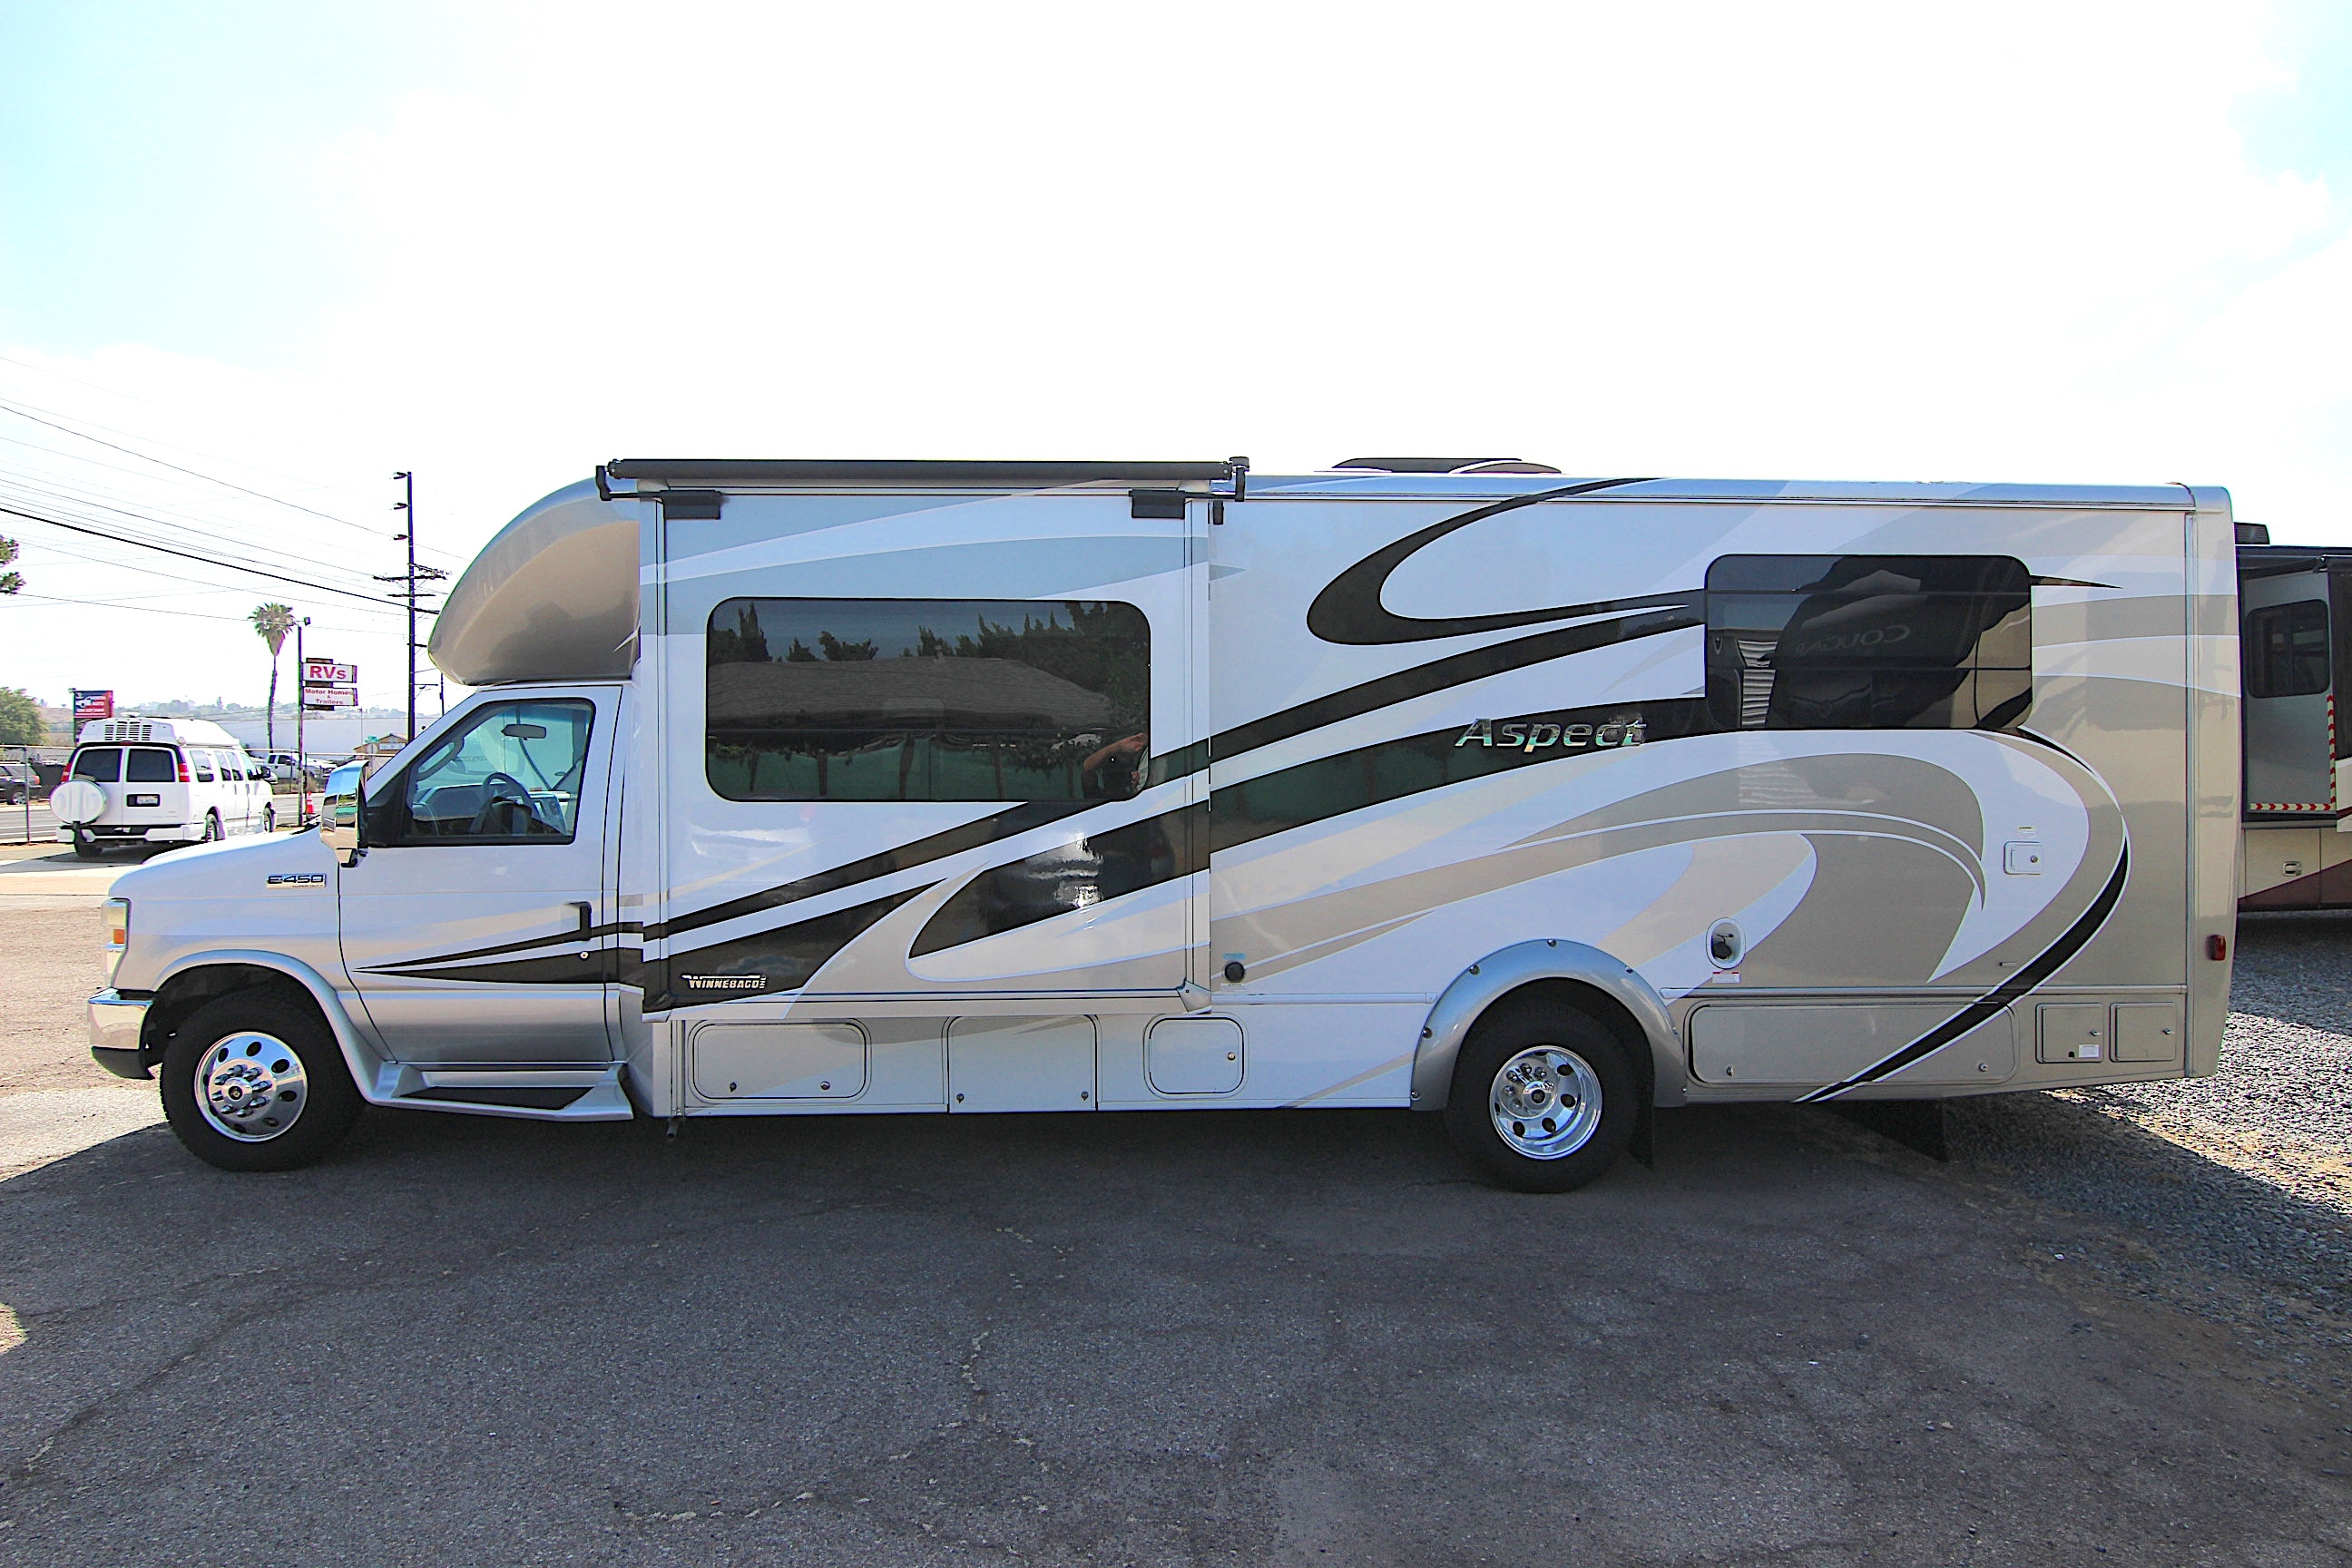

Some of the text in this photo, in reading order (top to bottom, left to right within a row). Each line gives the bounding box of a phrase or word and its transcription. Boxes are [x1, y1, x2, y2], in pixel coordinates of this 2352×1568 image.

[309, 665, 347, 679] RVs
[1455, 718, 1647, 753] Aspect
[681, 975, 760, 989] WINNEBAGO
